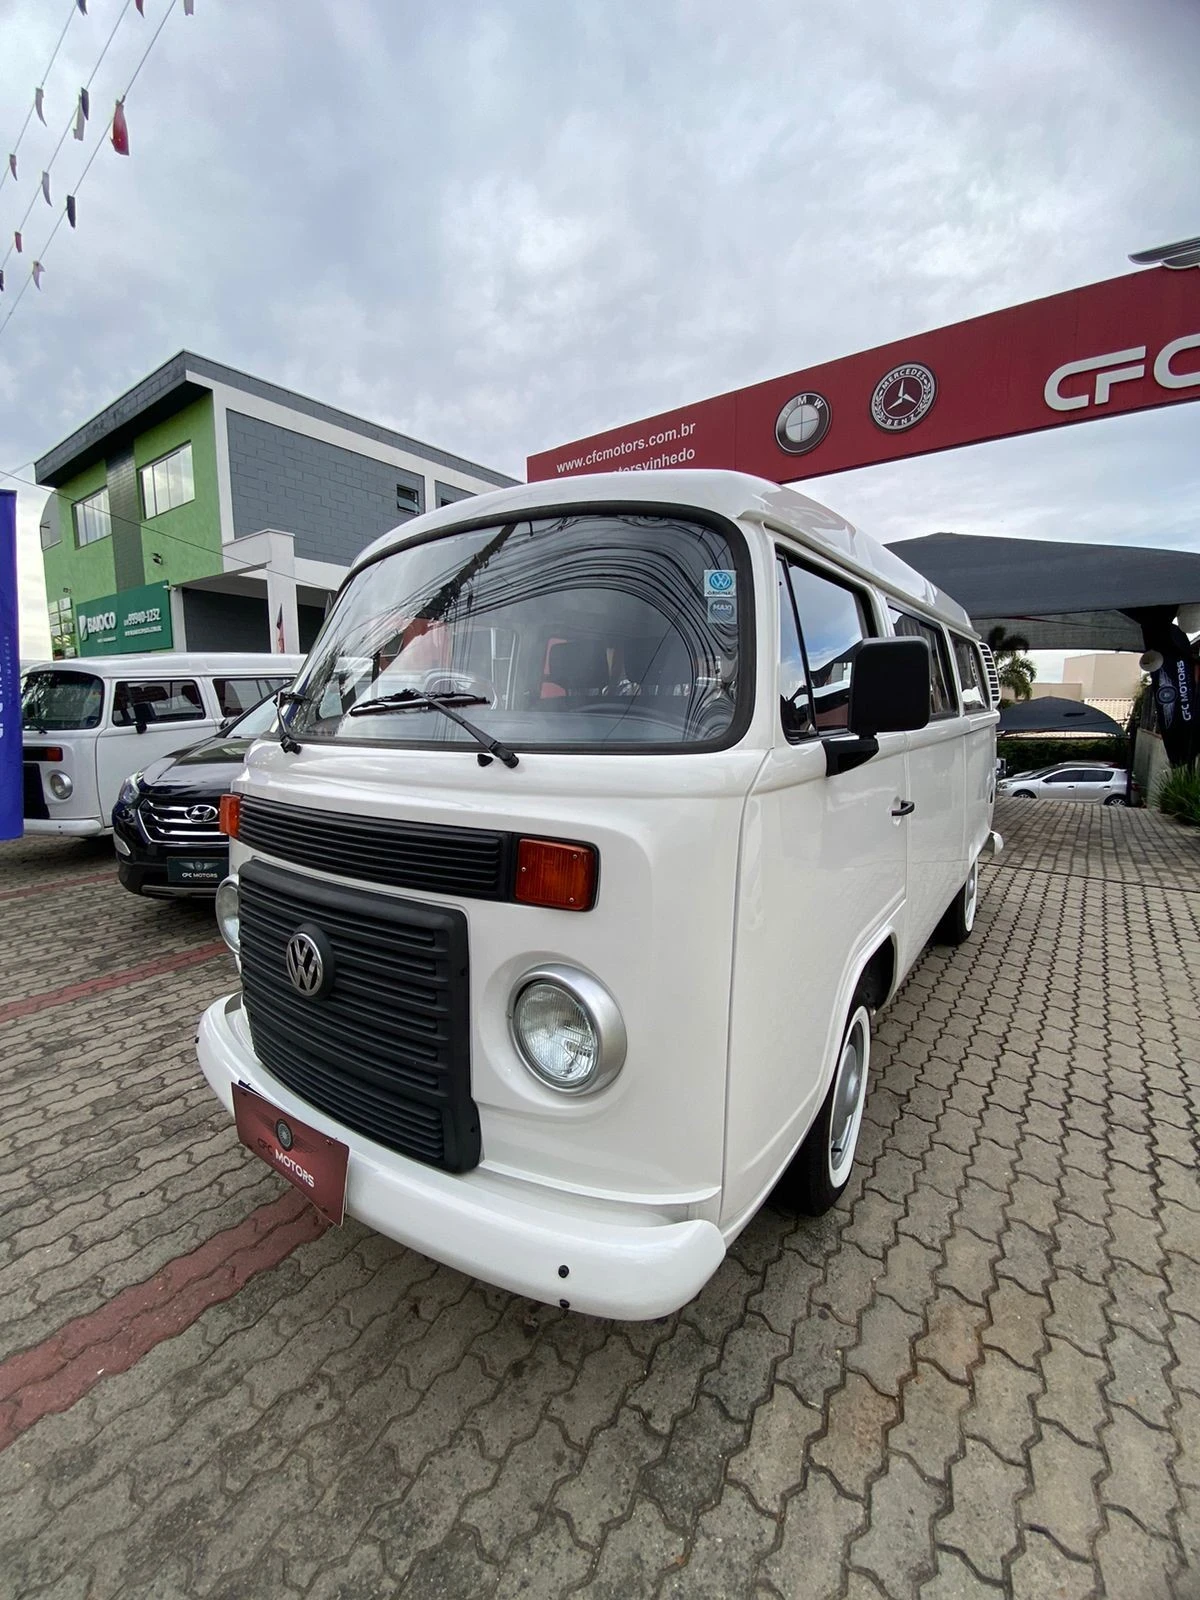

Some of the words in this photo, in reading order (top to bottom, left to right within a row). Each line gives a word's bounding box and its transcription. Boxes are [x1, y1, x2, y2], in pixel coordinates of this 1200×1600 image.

[881, 367, 927, 389] MERCEDES
[783, 396, 824, 418] BMW
[886, 413, 915, 427] BENZ
[556, 421, 696, 474] www.cfcmotors.com.br
[1177, 660, 1188, 702] MOTORS
[1181, 703, 1192, 721] CFC
[275, 1148, 315, 1188] MOTORS
